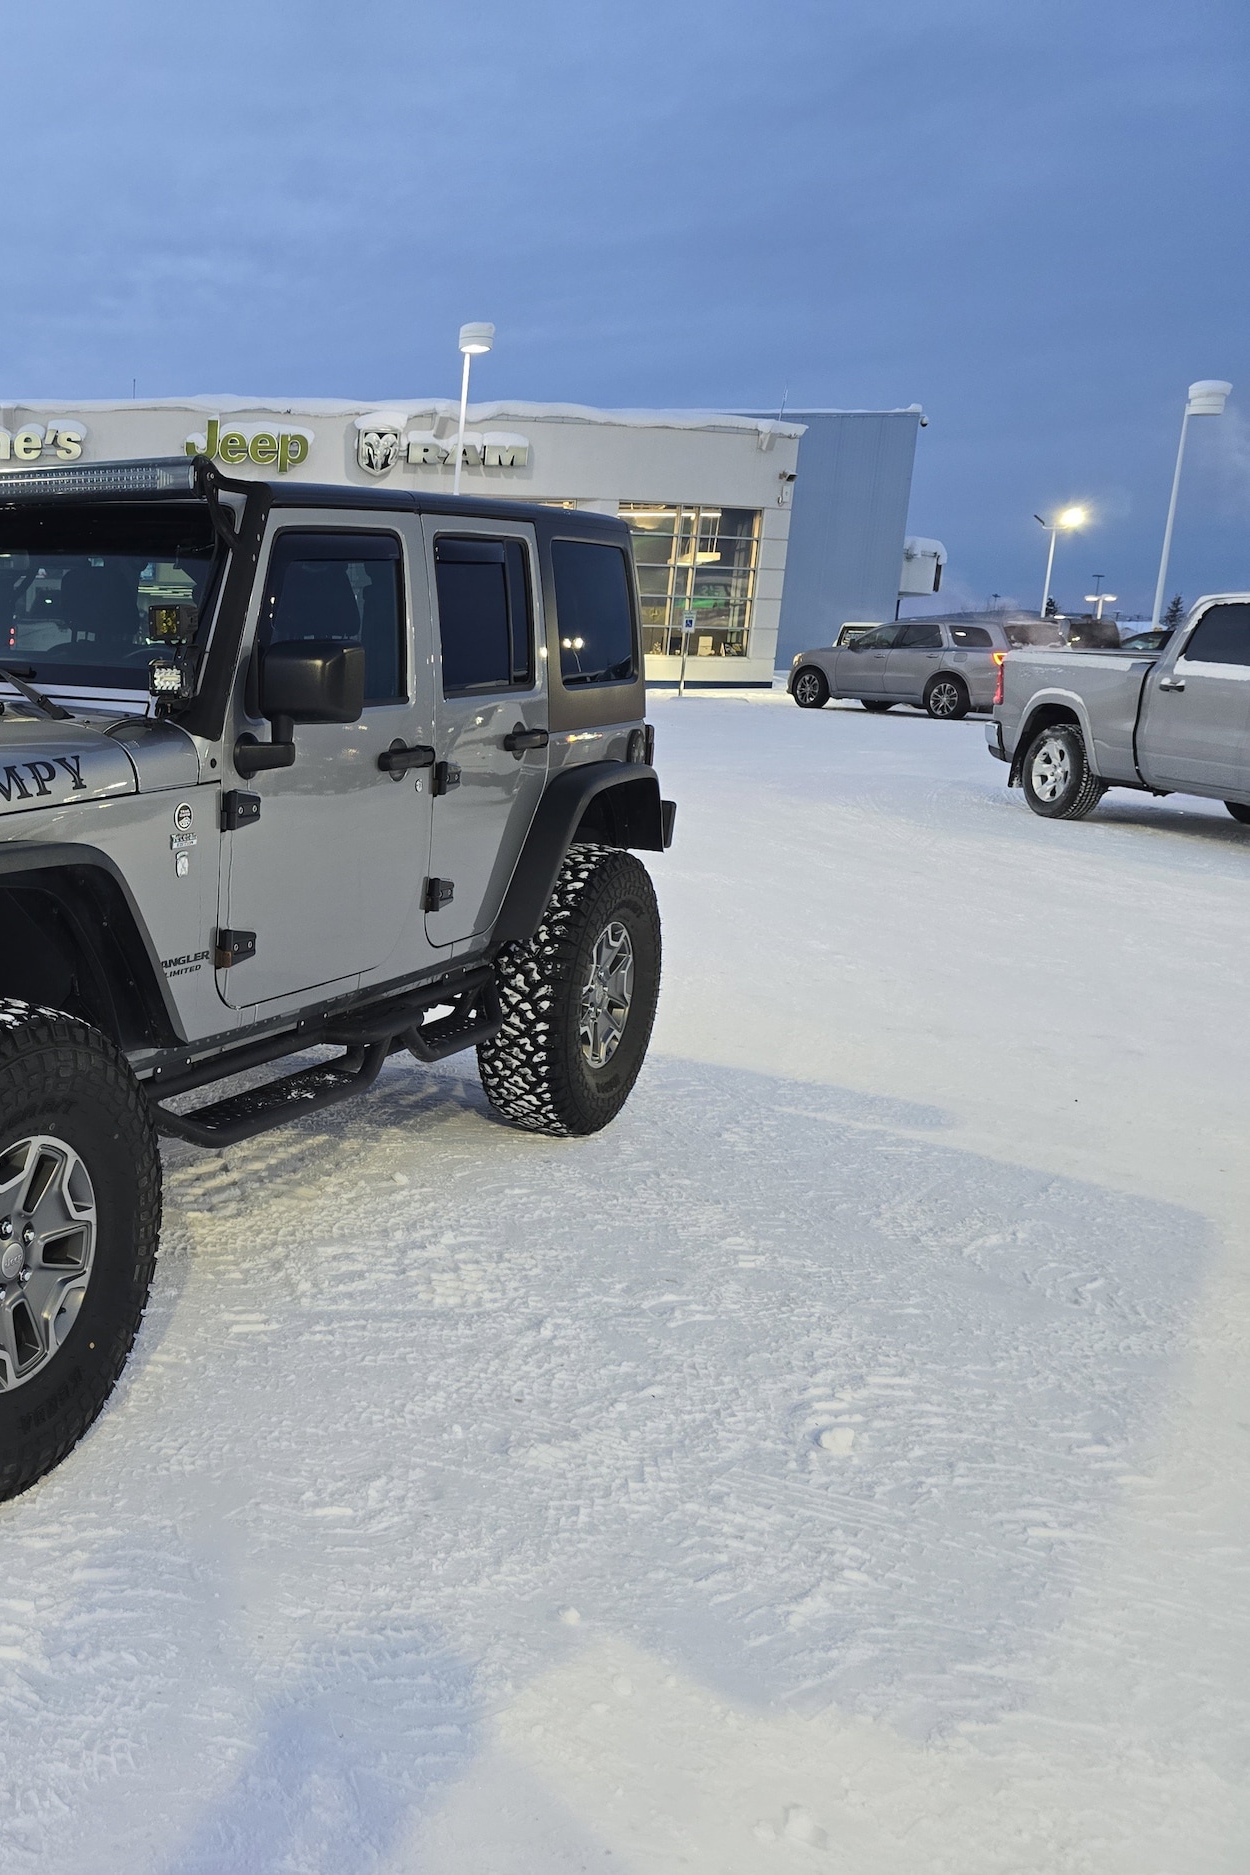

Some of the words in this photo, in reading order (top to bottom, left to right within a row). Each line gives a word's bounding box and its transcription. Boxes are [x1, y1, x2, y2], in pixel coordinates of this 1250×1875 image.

[185, 418, 310, 474] Jeep
[406, 442, 529, 467] RAM
[161, 950, 210, 968] ANGLER
[164, 964, 202, 978] LIMITED
